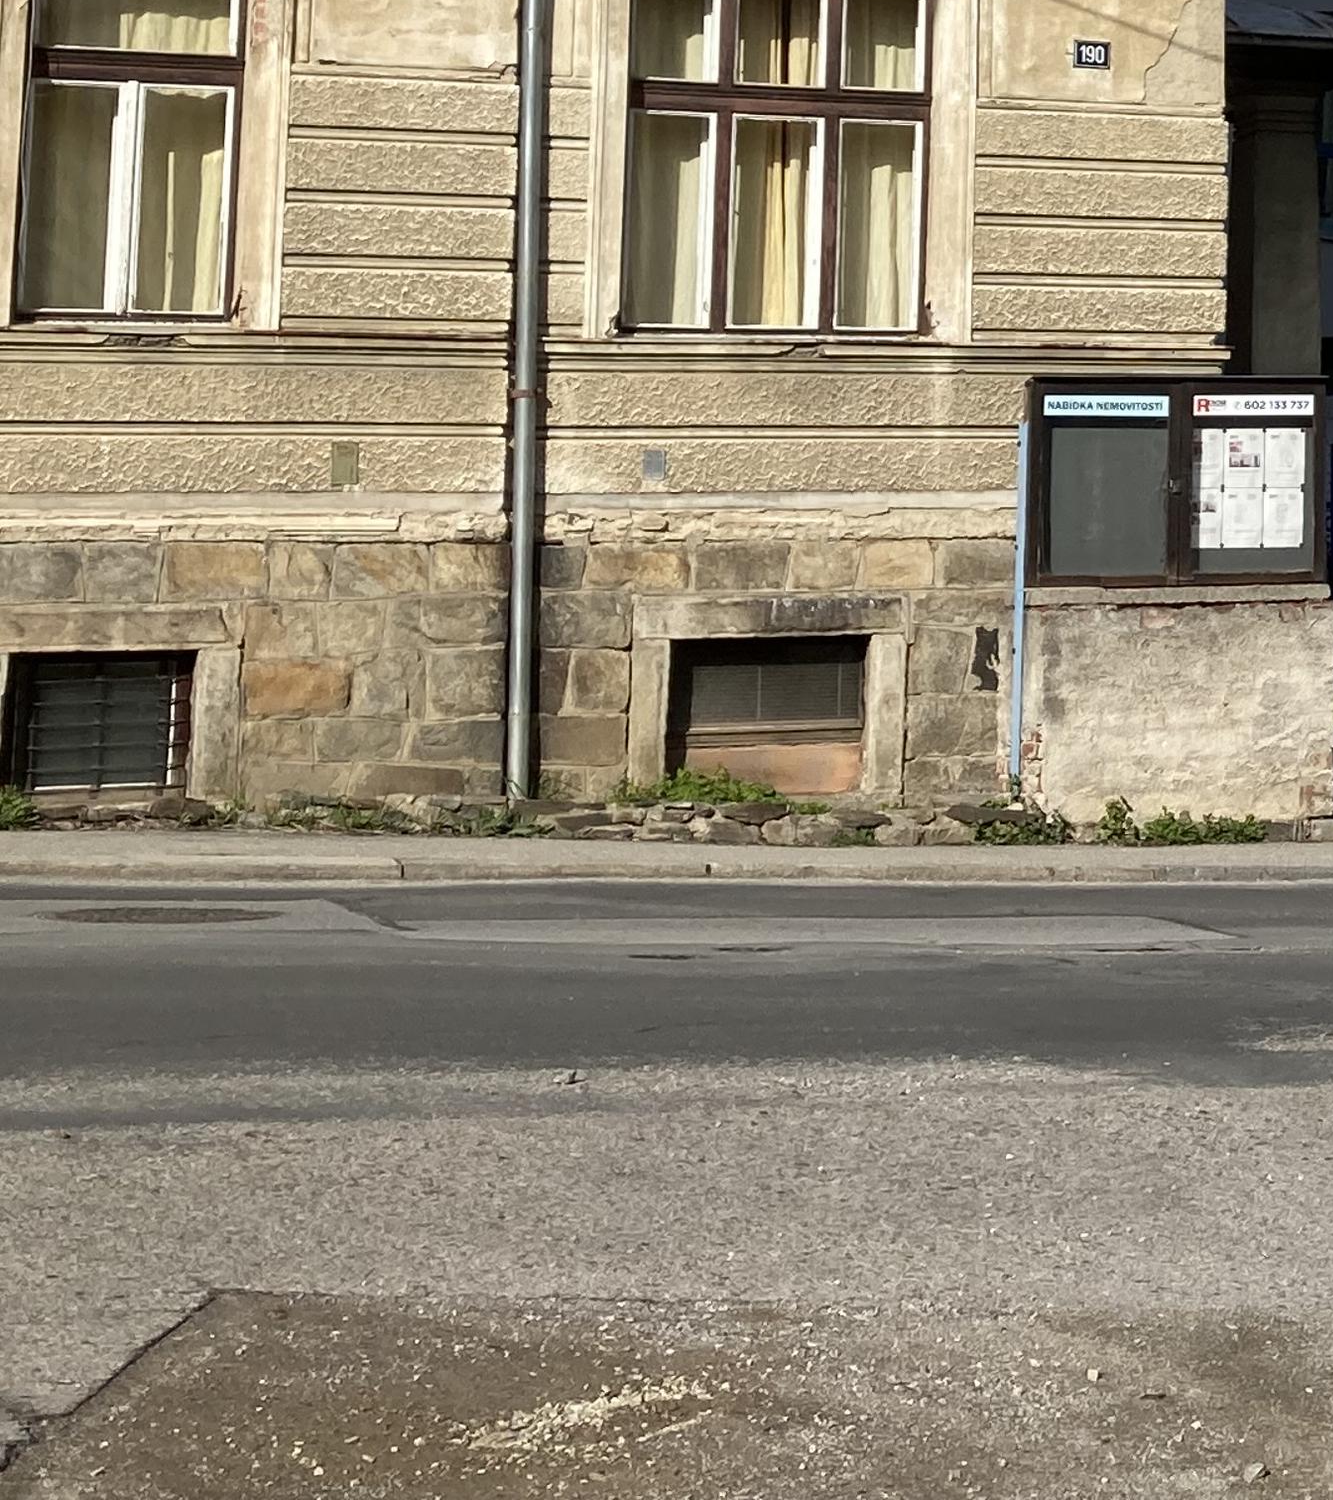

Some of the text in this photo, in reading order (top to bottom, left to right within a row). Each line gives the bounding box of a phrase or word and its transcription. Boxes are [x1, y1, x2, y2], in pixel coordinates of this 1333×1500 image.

[1079, 45, 1105, 64] 190
[1047, 400, 1094, 410] NABÍDKA
[1244, 400, 1310, 410] 602 133 737
